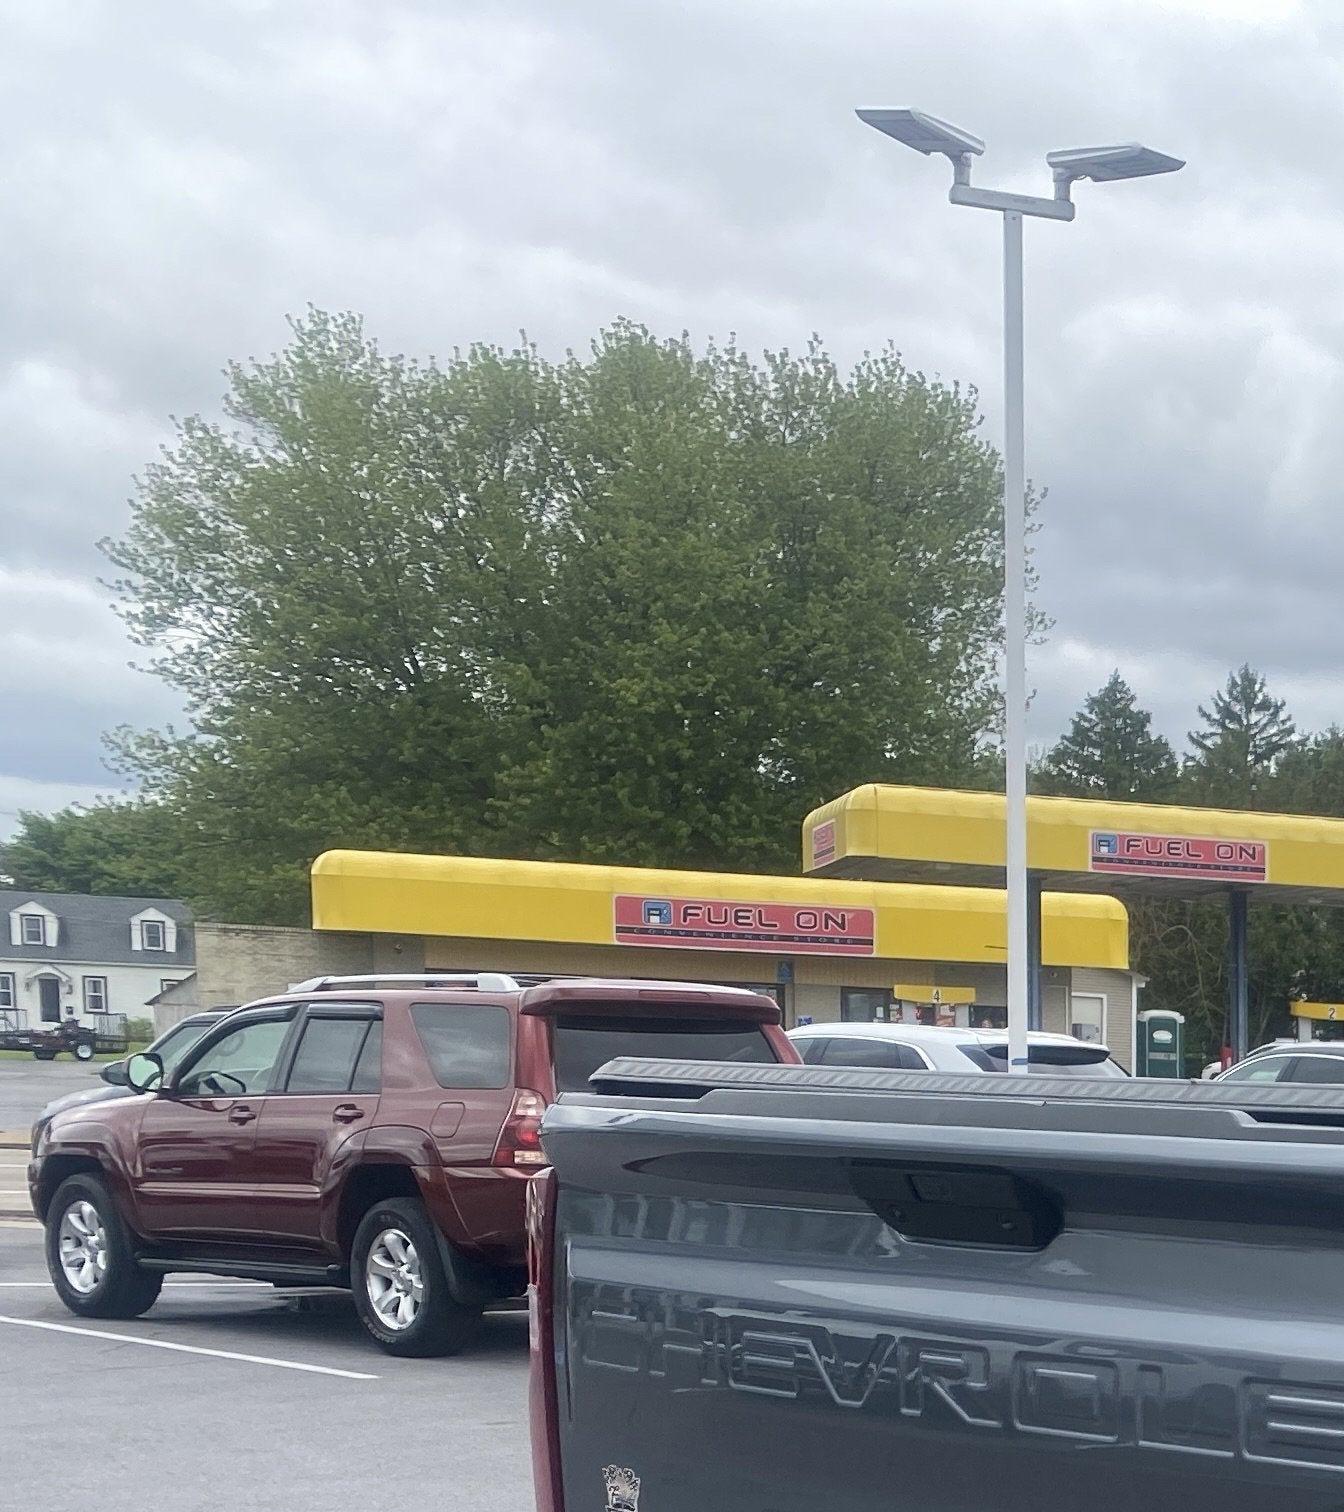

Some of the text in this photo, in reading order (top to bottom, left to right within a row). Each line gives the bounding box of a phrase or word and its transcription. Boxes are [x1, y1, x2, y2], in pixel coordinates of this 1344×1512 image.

[1125, 837, 1258, 862] FUEL ON
[681, 904, 850, 932] FUEL ON
[933, 988, 941, 1002] 4
[1328, 1007, 1336, 1020] 2
